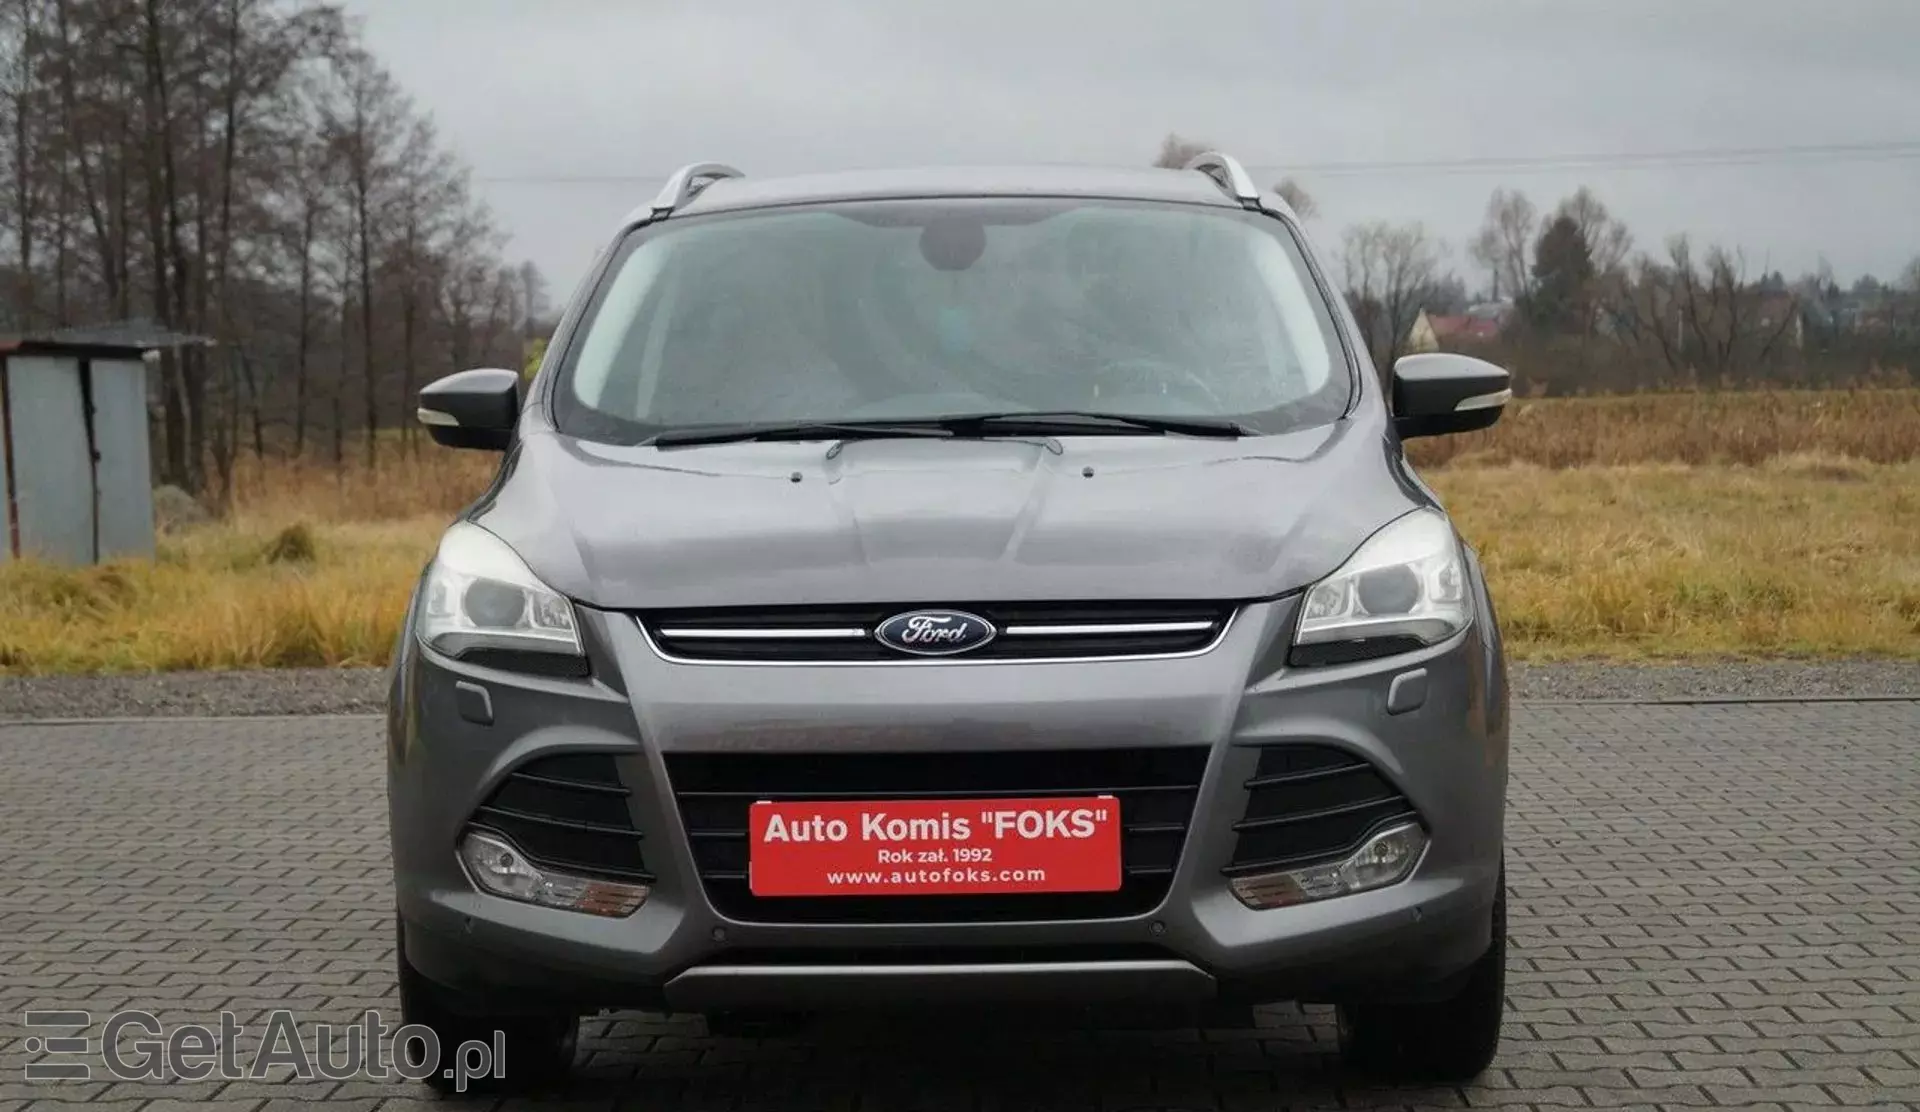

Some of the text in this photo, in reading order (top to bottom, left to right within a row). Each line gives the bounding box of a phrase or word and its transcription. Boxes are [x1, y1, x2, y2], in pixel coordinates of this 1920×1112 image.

[901, 616, 968, 643] Ford
[763, 809, 1107, 842] Auto Komis "FOKS"
[877, 848, 993, 863] Rok zał. 1992
[827, 866, 1046, 885] www.autofoks.com
